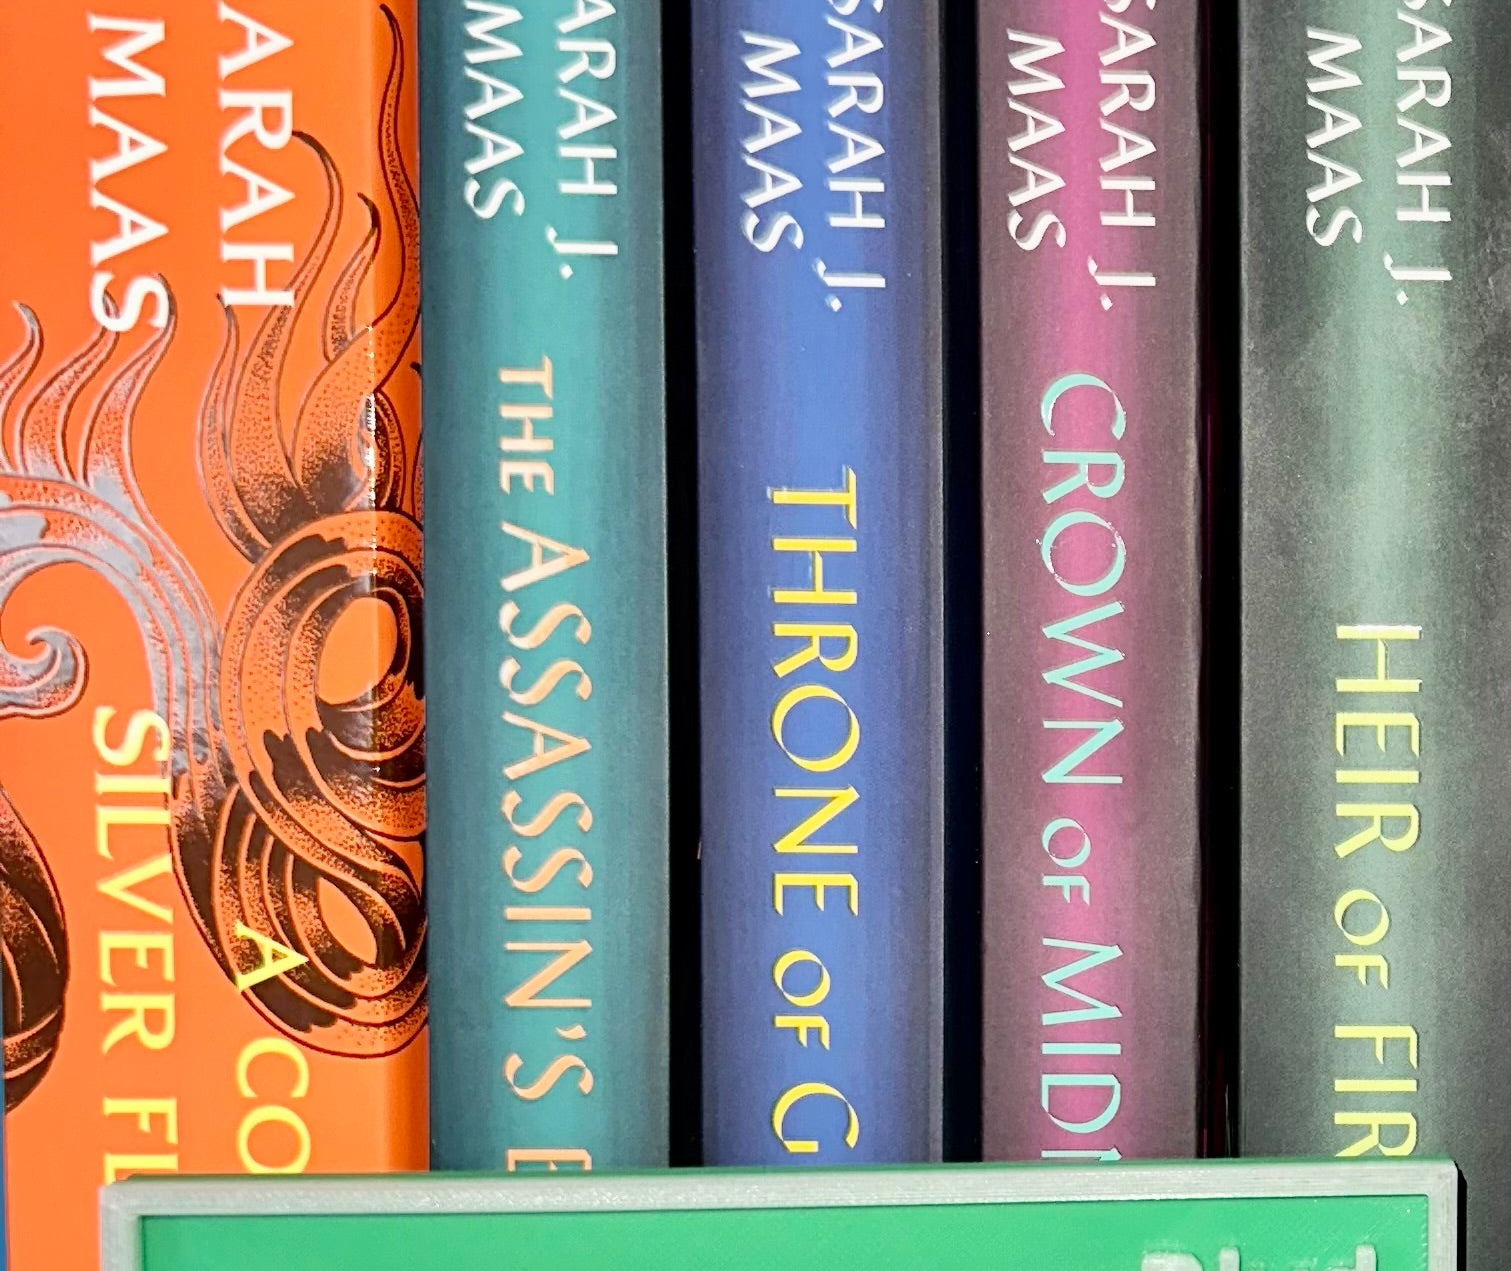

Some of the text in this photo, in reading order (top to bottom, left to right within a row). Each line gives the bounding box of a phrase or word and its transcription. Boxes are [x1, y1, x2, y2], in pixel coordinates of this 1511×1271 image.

[88, 13, 170, 333] MAAS
[740, 29, 803, 253] MAAS
[1006, 28, 1066, 251] MAAS
[1306, 26, 1362, 248] MAAS
[547, 225, 617, 280] J.
[812, 258, 885, 312] J.
[1088, 257, 1157, 310] J.
[1384, 253, 1453, 306] J.
[498, 356, 554, 495] THE
[767, 466, 860, 918] THRONE
[1040, 372, 1127, 1161] CROWN OF MID
[1335, 624, 1421, 859] HEIR
[92, 707, 178, 1055] SILVER
[498, 523, 594, 1101] ASSASSIN'S
[234, 920, 310, 989] A
[772, 949, 831, 1051] OF
[1334, 888, 1389, 990] OF
